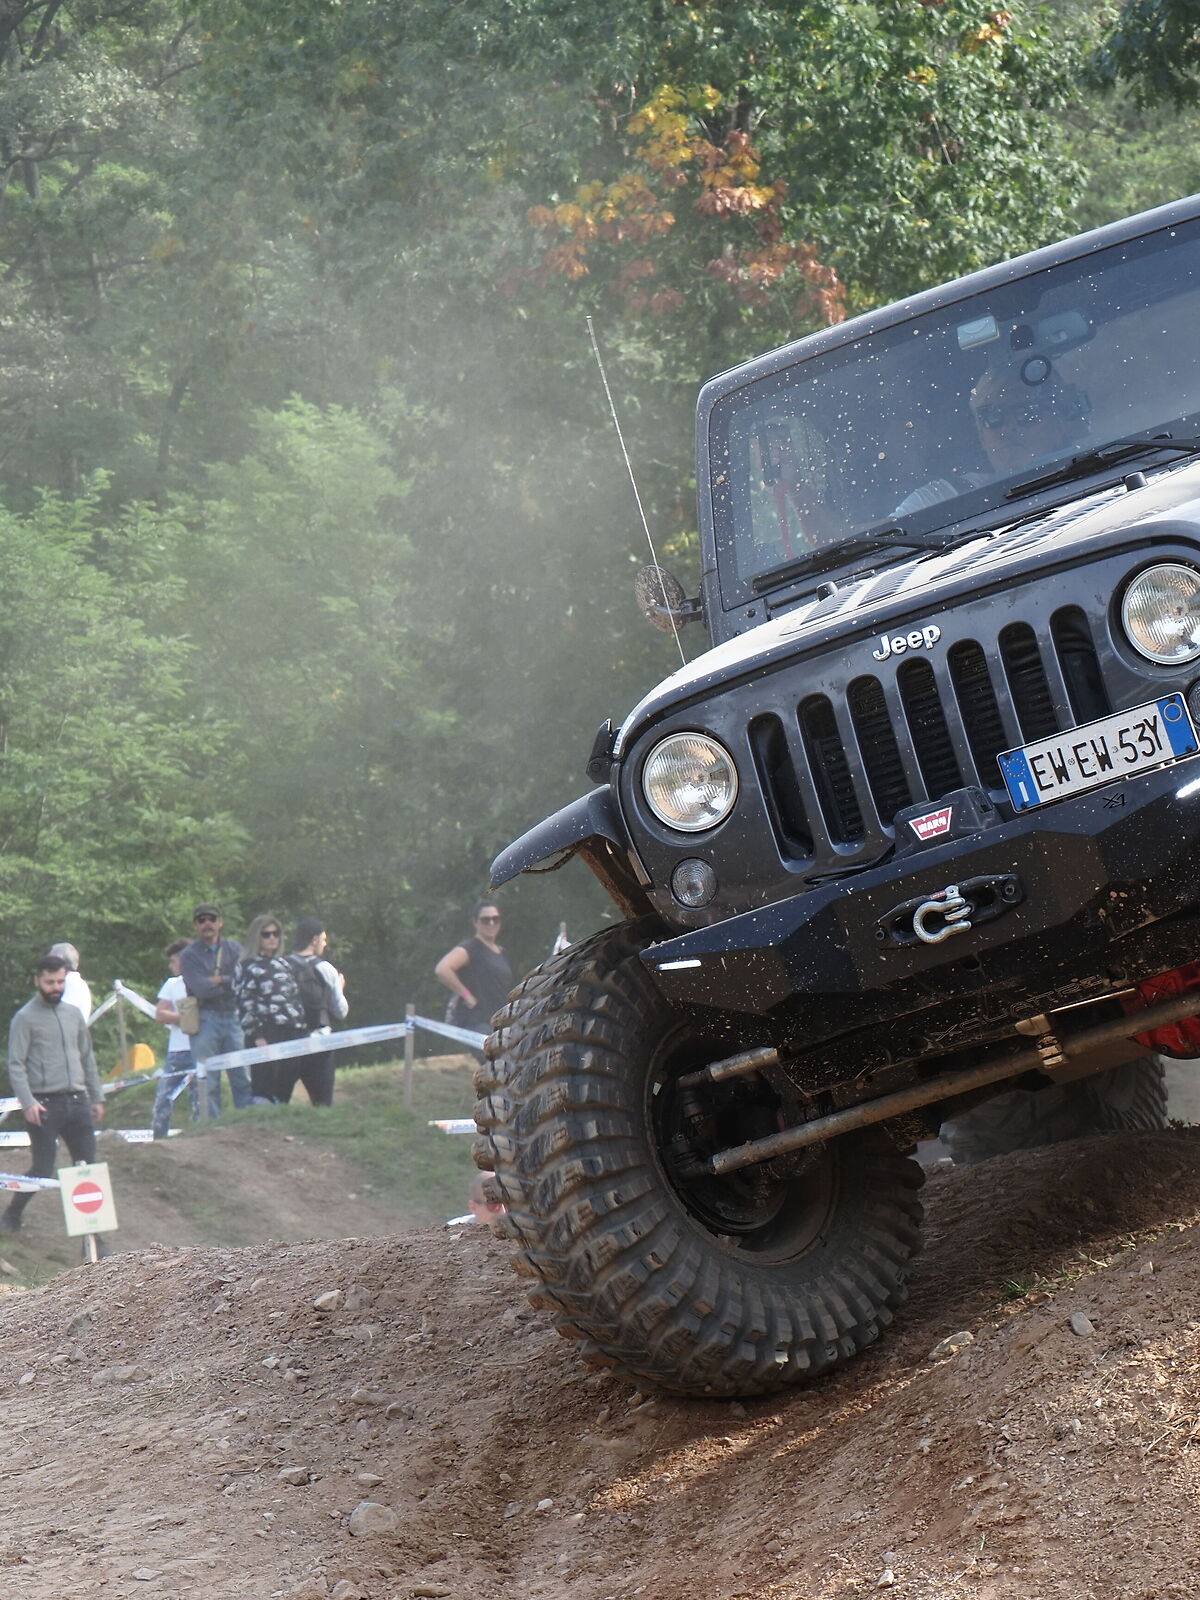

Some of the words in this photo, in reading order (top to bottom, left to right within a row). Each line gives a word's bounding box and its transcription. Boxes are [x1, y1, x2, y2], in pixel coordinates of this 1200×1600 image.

[872, 624, 941, 661] Jeep
[1028, 747, 1071, 791] EW
[1072, 735, 1114, 778] EW
[1117, 714, 1163, 764] 53Y
[917, 816, 947, 834] WARN
